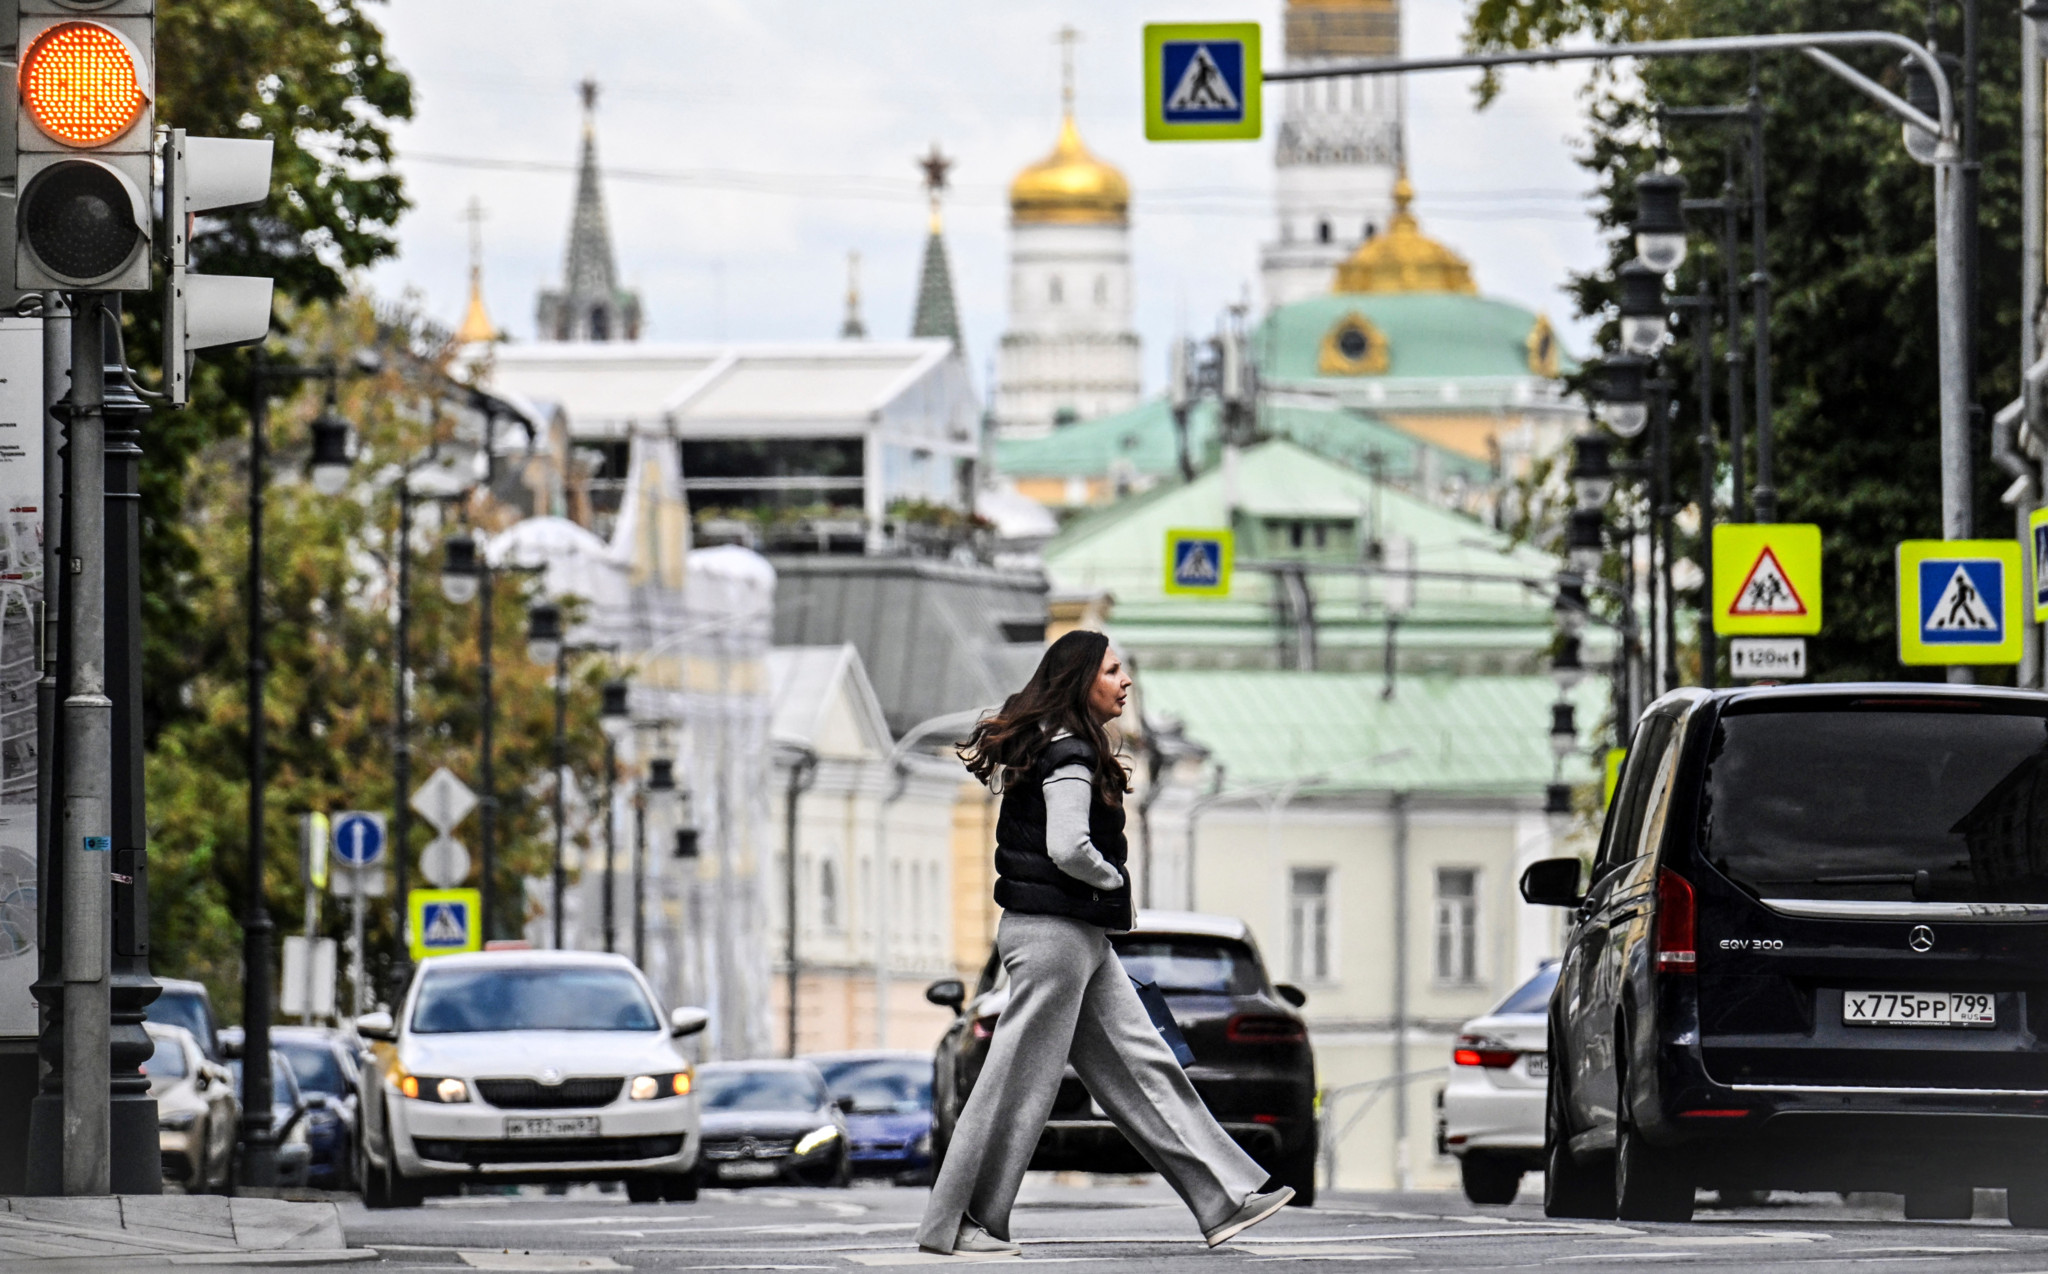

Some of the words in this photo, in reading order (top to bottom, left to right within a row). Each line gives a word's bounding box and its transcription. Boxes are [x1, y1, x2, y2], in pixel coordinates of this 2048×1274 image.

[1719, 939, 1749, 950] EQV
[1752, 939, 1784, 950] 300
[1952, 995, 1989, 1014] 799
[1961, 1013, 1980, 1021] RUS
